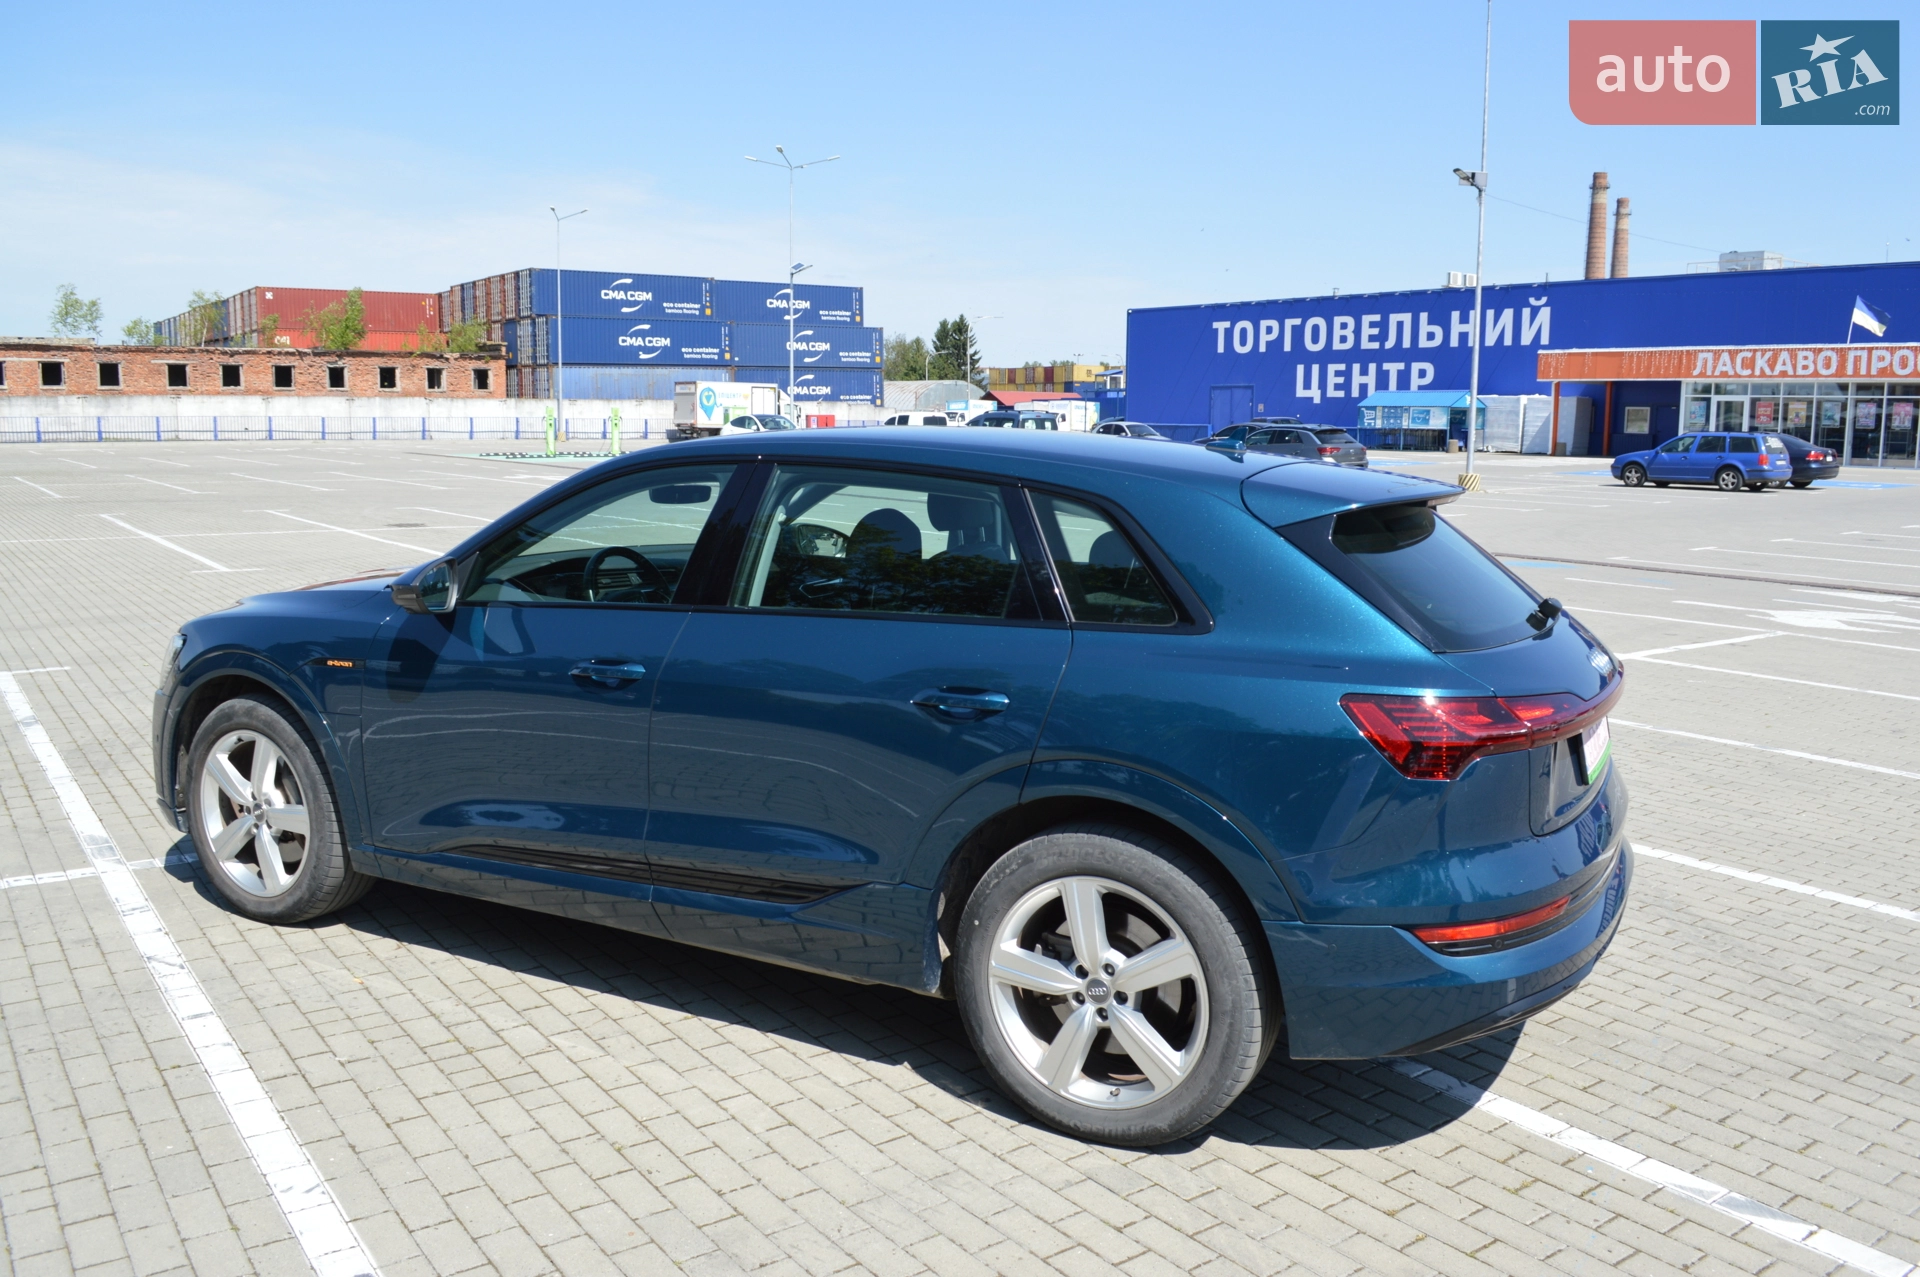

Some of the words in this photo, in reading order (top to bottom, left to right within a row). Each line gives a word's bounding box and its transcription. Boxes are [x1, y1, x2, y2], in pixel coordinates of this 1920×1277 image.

[600, 289, 626, 300] CMA
[627, 291, 652, 301] CGM
[766, 299, 788, 309] CMA
[1212, 296, 1551, 354] ТОРГОВЕЛЬНИЙ
[618, 336, 644, 346] CMA
[645, 337, 670, 347] CGM
[809, 342, 830, 351] CGM
[1692, 350, 1837, 376] ЛАСКАВО
[1296, 361, 1435, 404] ЦЕНТР
[809, 386, 831, 395] CGM
